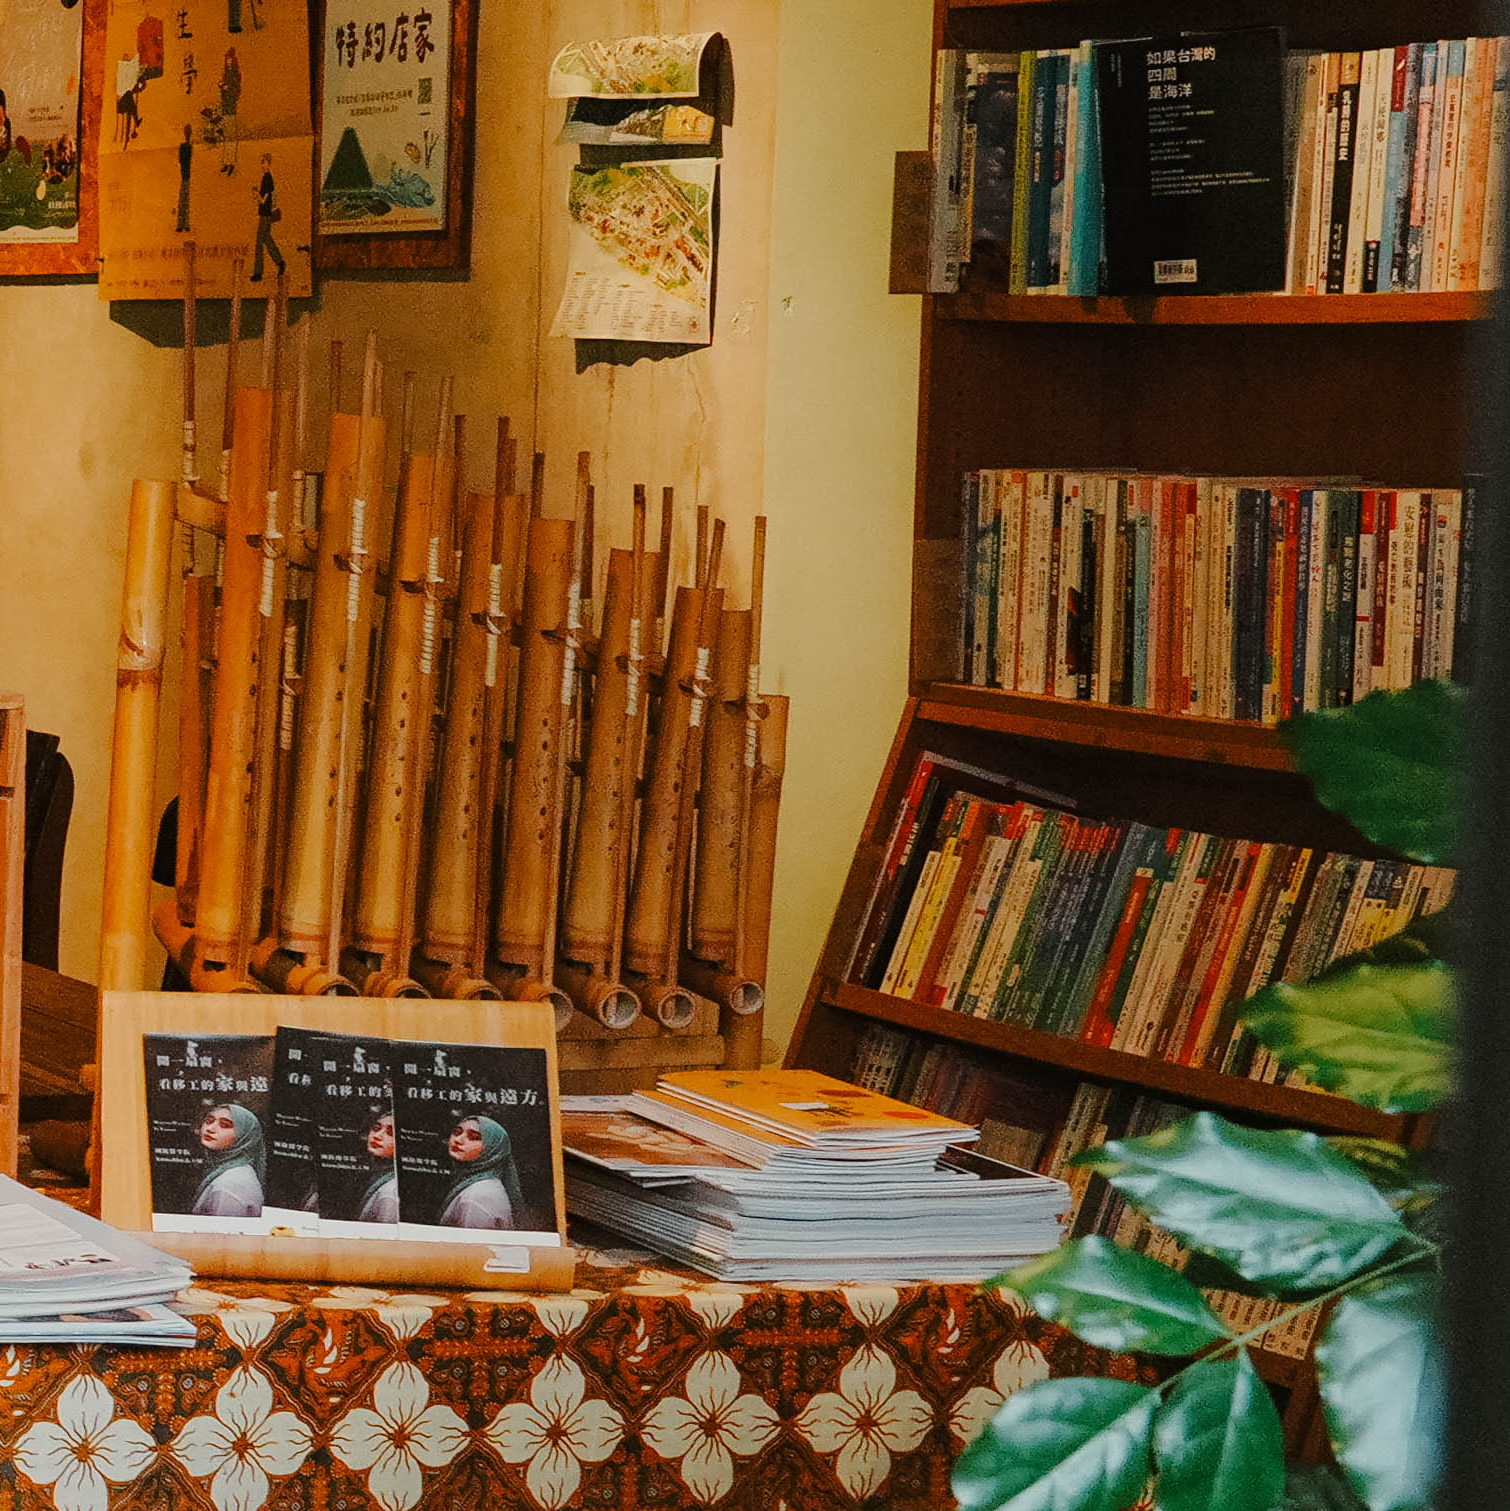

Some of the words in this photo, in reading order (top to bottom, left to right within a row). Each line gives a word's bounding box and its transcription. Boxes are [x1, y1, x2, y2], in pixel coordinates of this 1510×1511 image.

[335, 7, 435, 69] 特約店家
[1146, 46, 1216, 65] 如果台灣的
[1148, 83, 1193, 100] 是海洋
